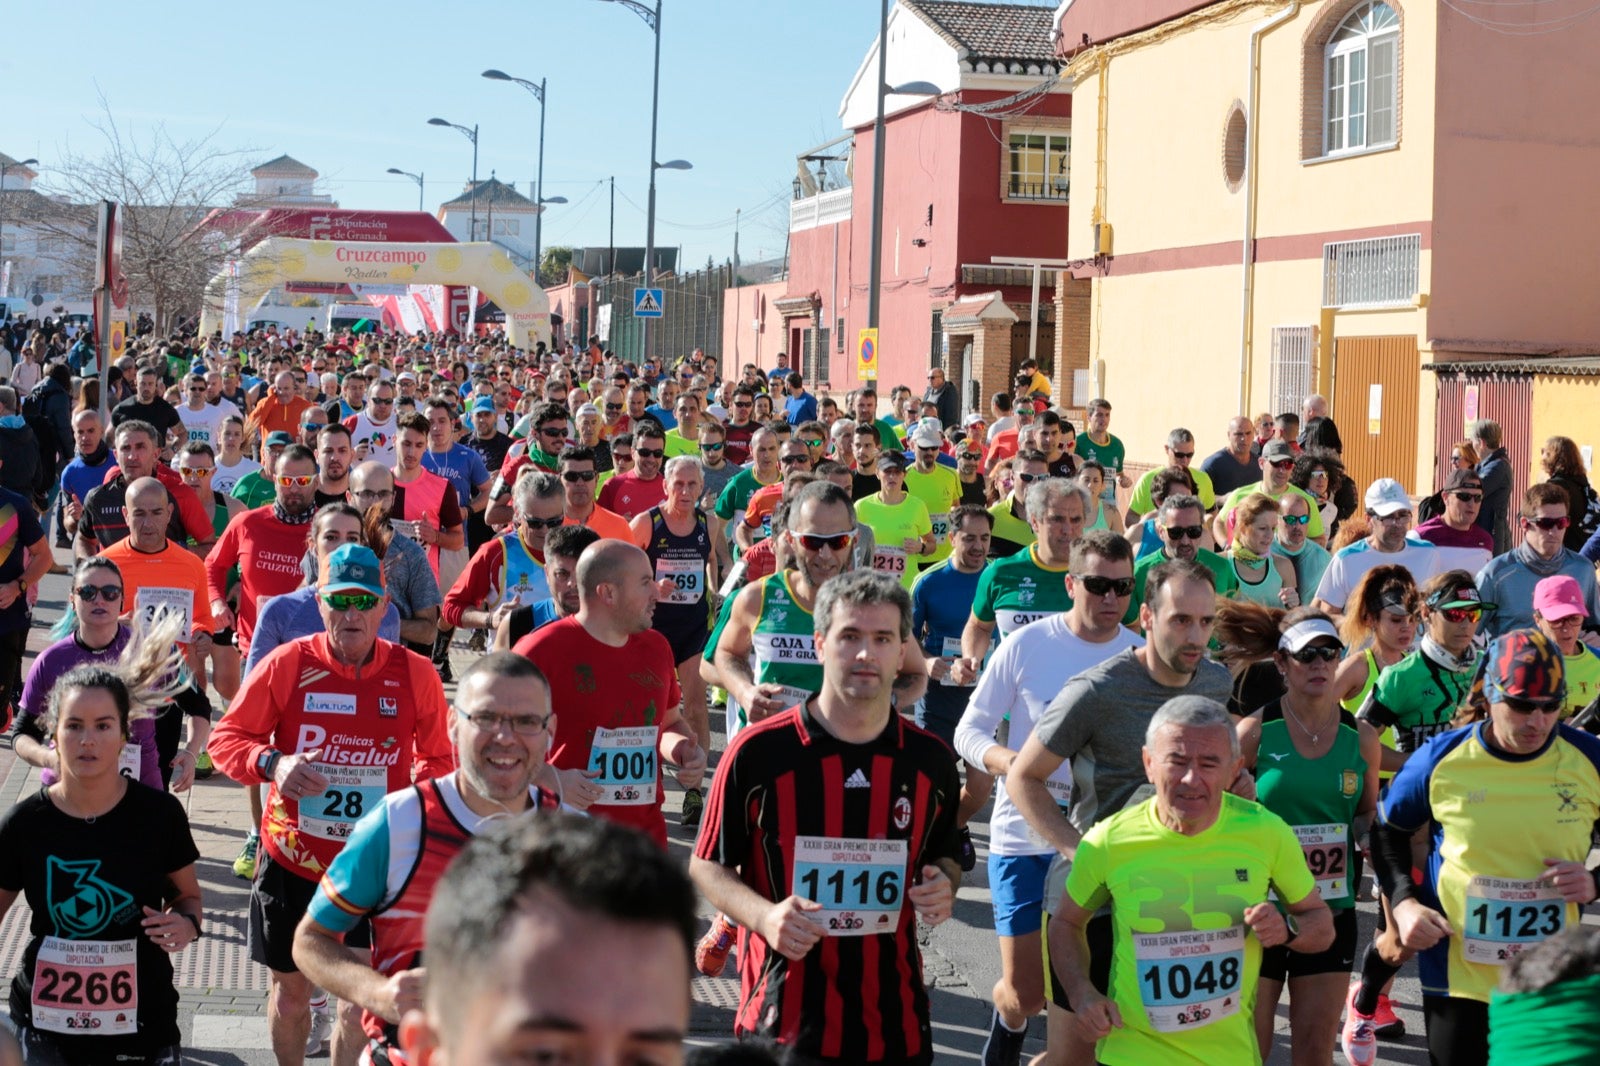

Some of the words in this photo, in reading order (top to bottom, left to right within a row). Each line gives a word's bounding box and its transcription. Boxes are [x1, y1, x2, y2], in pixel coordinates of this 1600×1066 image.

[334, 218, 388, 229] Diputación
[334, 231, 346, 240] de
[346, 231, 388, 241] Granada
[336, 247, 427, 265] Cruzcampo
[344, 266, 388, 279] Radler
[258, 549, 299, 564] carrera
[255, 558, 304, 577] cruzroja
[770, 637, 804, 649] CAJA
[779, 649, 792, 658] DE
[295, 724, 400, 766] Plisalud
[331, 734, 375, 746] Clínicas
[323, 766, 338, 775] GRAN
[338, 767, 359, 777] PREMIO
[359, 768, 366, 777] DE
[595, 751, 654, 780] 1001
[330, 776, 362, 785] DIPUTACIÓN
[323, 790, 363, 819] 28
[823, 841, 842, 851] GRAN
[843, 842, 868, 851] PREMIO
[869, 843, 877, 851] DE
[879, 843, 901, 852] FONDO
[832, 852, 871, 862] DIPUTACIÓN
[1303, 847, 1343, 876] 92
[801, 868, 899, 905] 1116
[1493, 879, 1509, 889] GRAN
[1510, 880, 1534, 890] PREMIO
[1534, 881, 1544, 890] DE
[1500, 889, 1537, 900] DIPUTACIÓN
[1473, 903, 1562, 937] 1123
[1159, 935, 1178, 946] GRAN
[1179, 932, 1205, 944] PREMIO
[1206, 931, 1214, 942] DE
[1216, 929, 1238, 940] FONDO
[59, 942, 74, 952] GRAN
[75, 943, 100, 954] PREMIO
[101, 944, 110, 954] DE
[111, 942, 131, 952] FONDO
[1169, 944, 1211, 957] DIPUTACIÓN
[66, 954, 104, 964] DIPUTACIÓN
[1144, 957, 1239, 1001] 1048
[37, 967, 133, 1005] 2266
